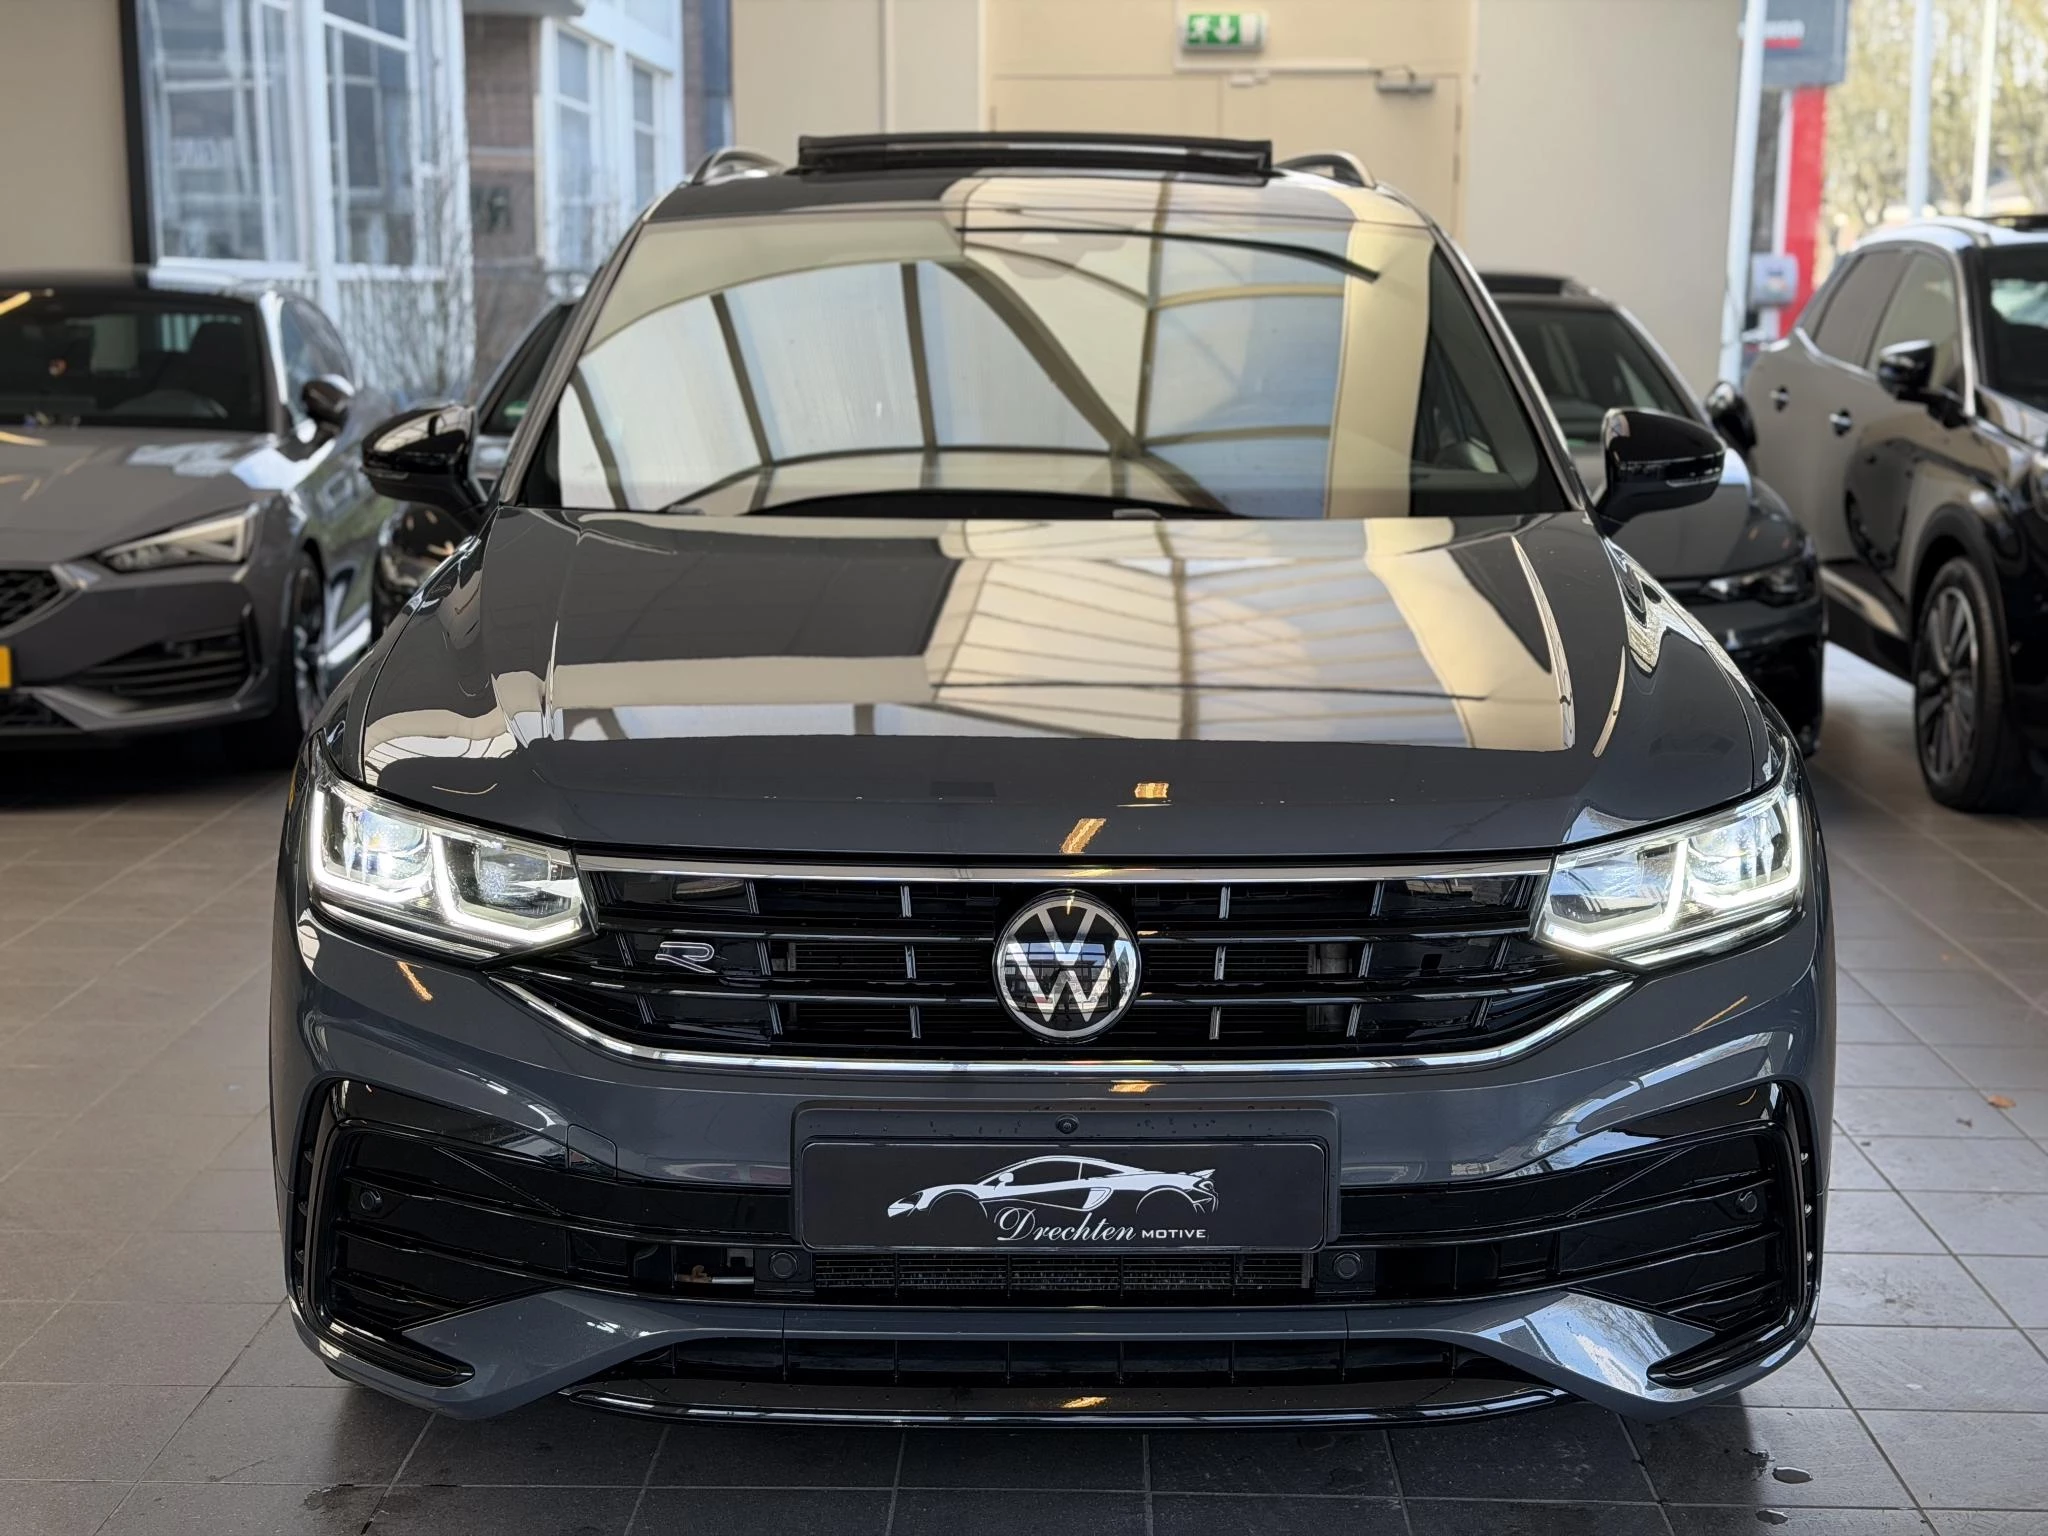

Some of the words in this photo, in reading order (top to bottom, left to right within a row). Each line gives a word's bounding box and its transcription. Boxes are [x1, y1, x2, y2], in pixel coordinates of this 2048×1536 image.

[655, 941, 717, 974] R
[993, 1206, 1137, 1241] Drechten
[1141, 1228, 1207, 1239] MOTIVE
